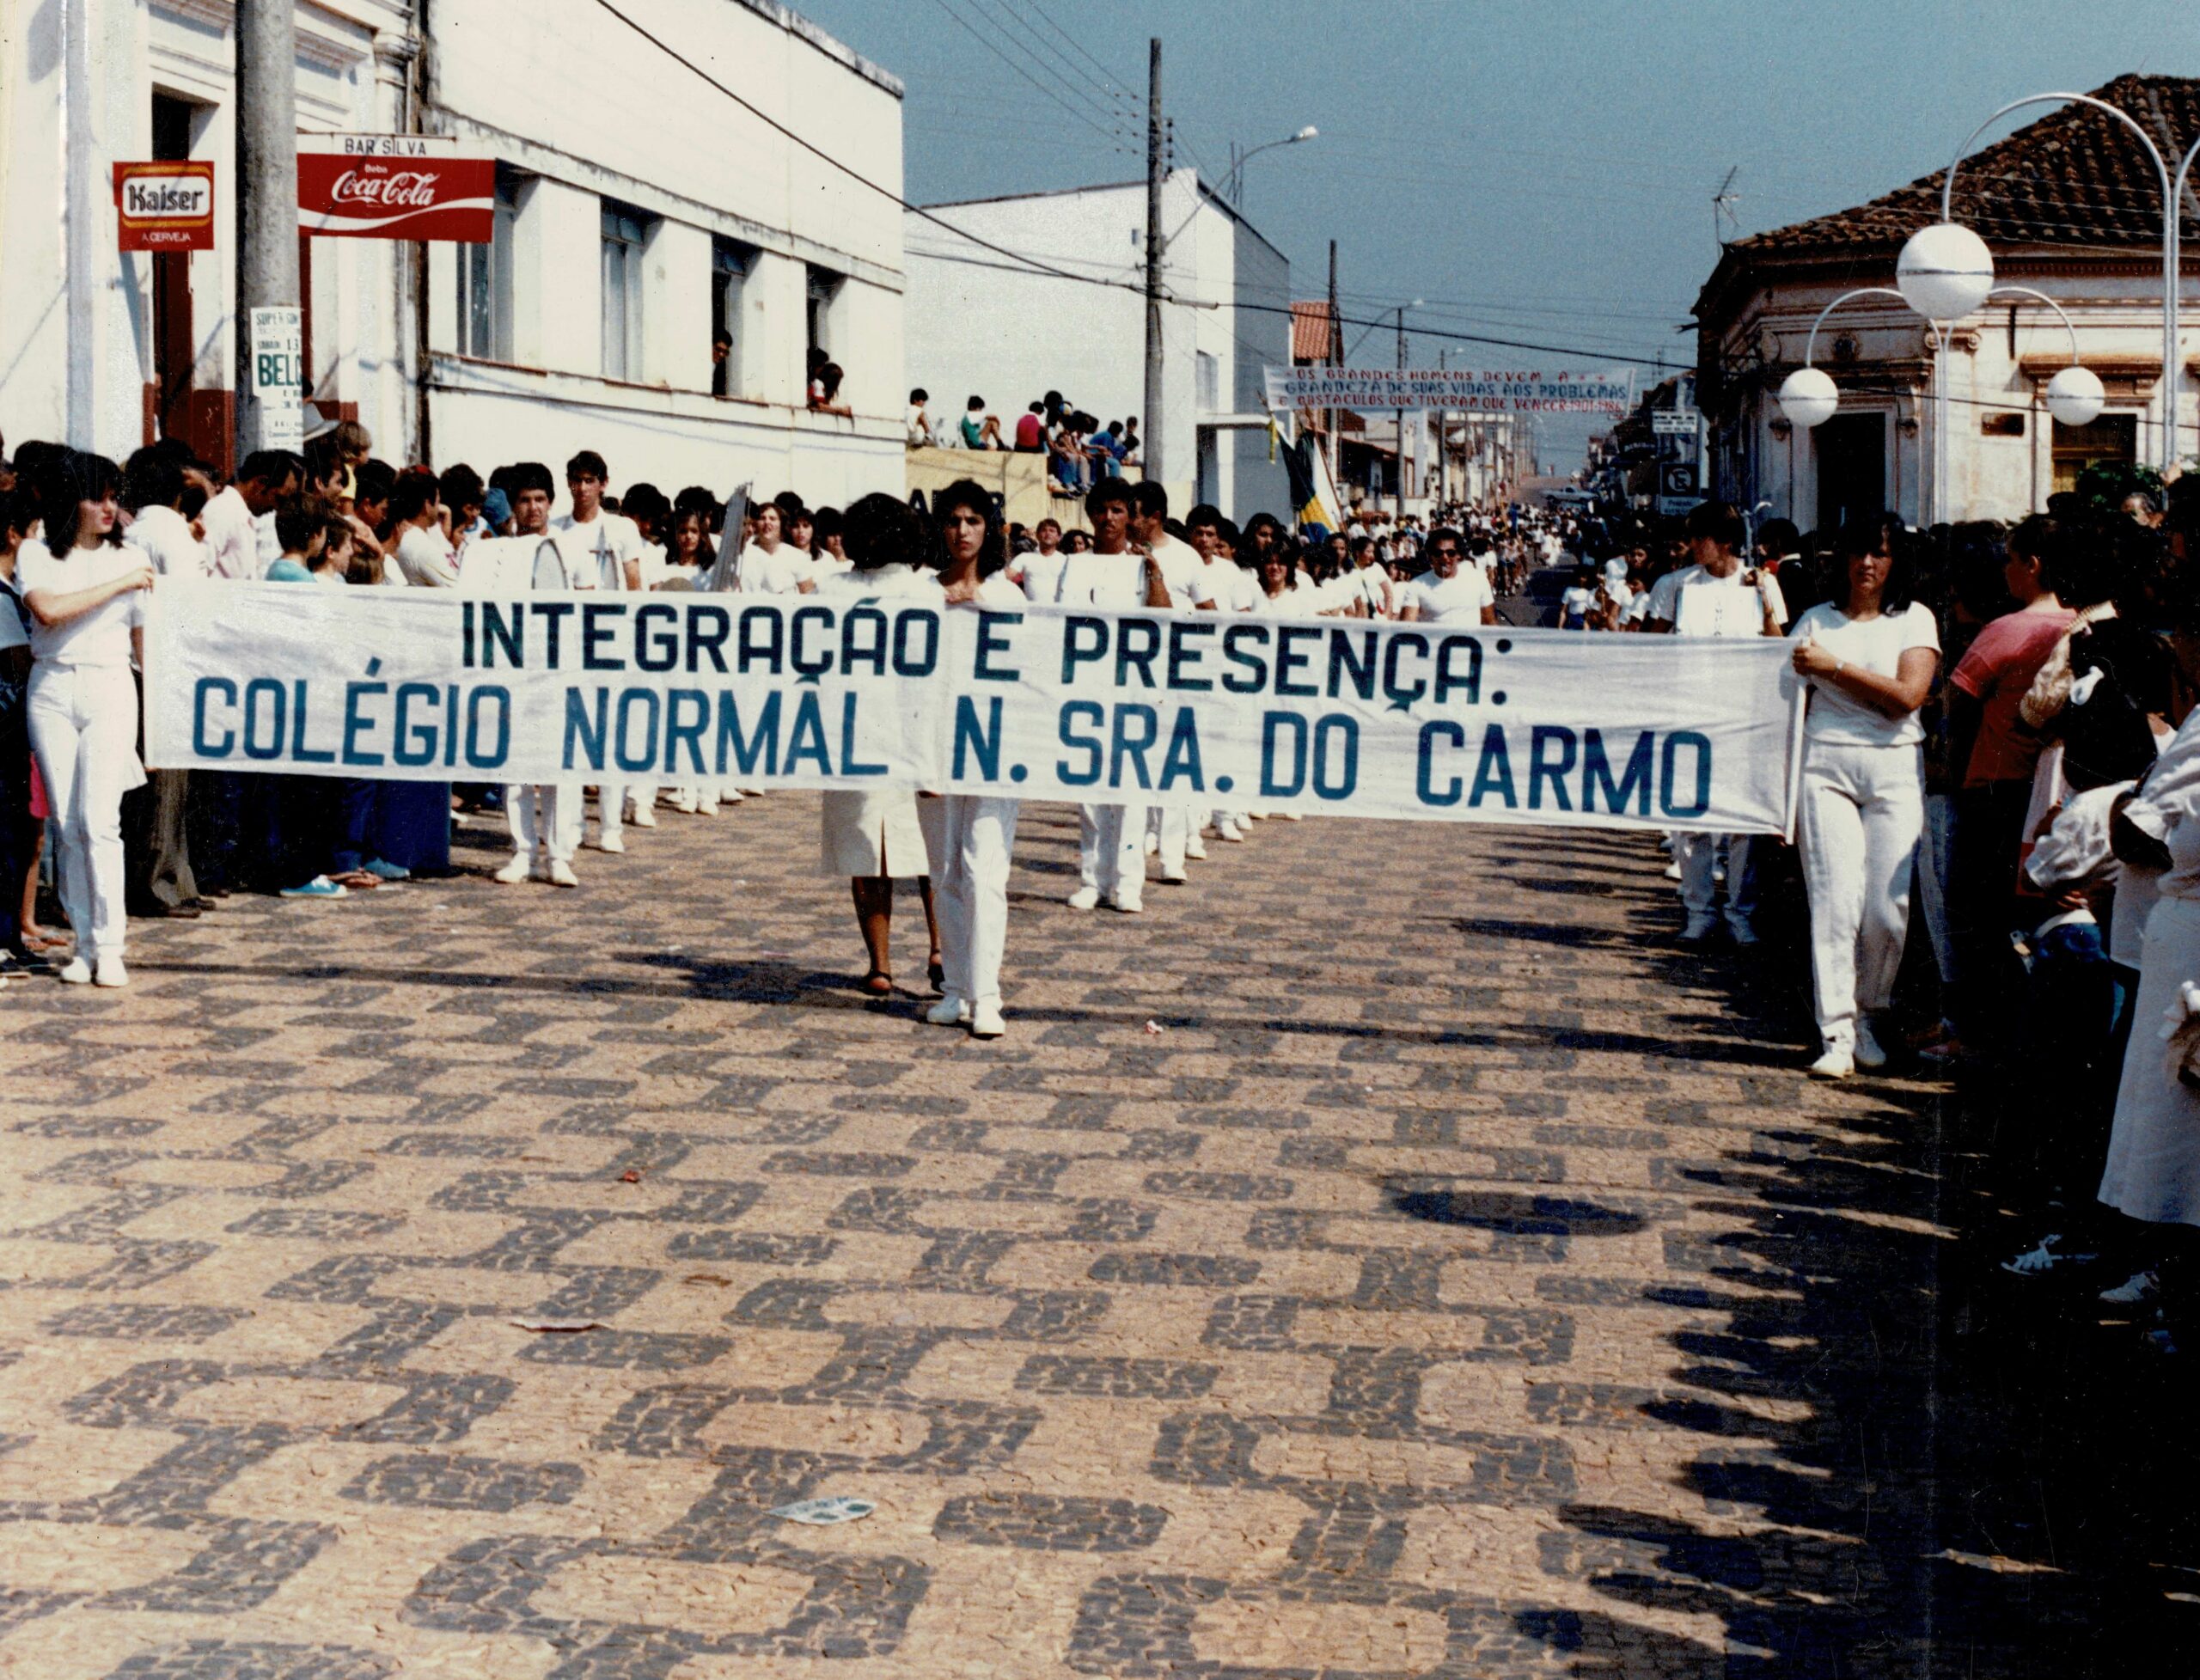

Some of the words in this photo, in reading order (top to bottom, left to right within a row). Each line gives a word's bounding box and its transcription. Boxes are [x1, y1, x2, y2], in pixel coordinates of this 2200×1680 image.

[345, 138, 376, 154] BAR
[382, 140, 427, 156] SILVA
[332, 170, 441, 205] Coca-Cola
[128, 184, 204, 211] Kaiser
[141, 232, 149, 241] A
[150, 232, 191, 242] CERVEJA
[1297, 370, 1316, 380] OS
[1326, 370, 1404, 381] GRANDES
[1409, 370, 1473, 381] HOMENS
[1482, 370, 1542, 382] DEVEM
[1558, 371, 1568, 382] A
[1285, 382, 1384, 394] GRANDEZA
[1386, 382, 1407, 394] DE
[1411, 382, 1445, 394] SUAS
[1451, 382, 1494, 395] VIDAS
[1503, 384, 1532, 397] AOS
[1539, 384, 1627, 400] PROBLEMAS
[1389, 395, 1415, 406] QUE
[1418, 395, 1478, 408] TIVERAM
[1482, 396, 1507, 410] QUE
[974, 612, 1024, 681] E
[1061, 615, 1513, 710] PRESENÇA:
[192, 657, 510, 767] COLÉGIO
[562, 686, 889, 776] NORMAL
[951, 696, 1029, 782] N.
[1057, 699, 1233, 793] SRA.
[1259, 710, 1360, 800] DO
[1415, 720, 1712, 818] CARMO
